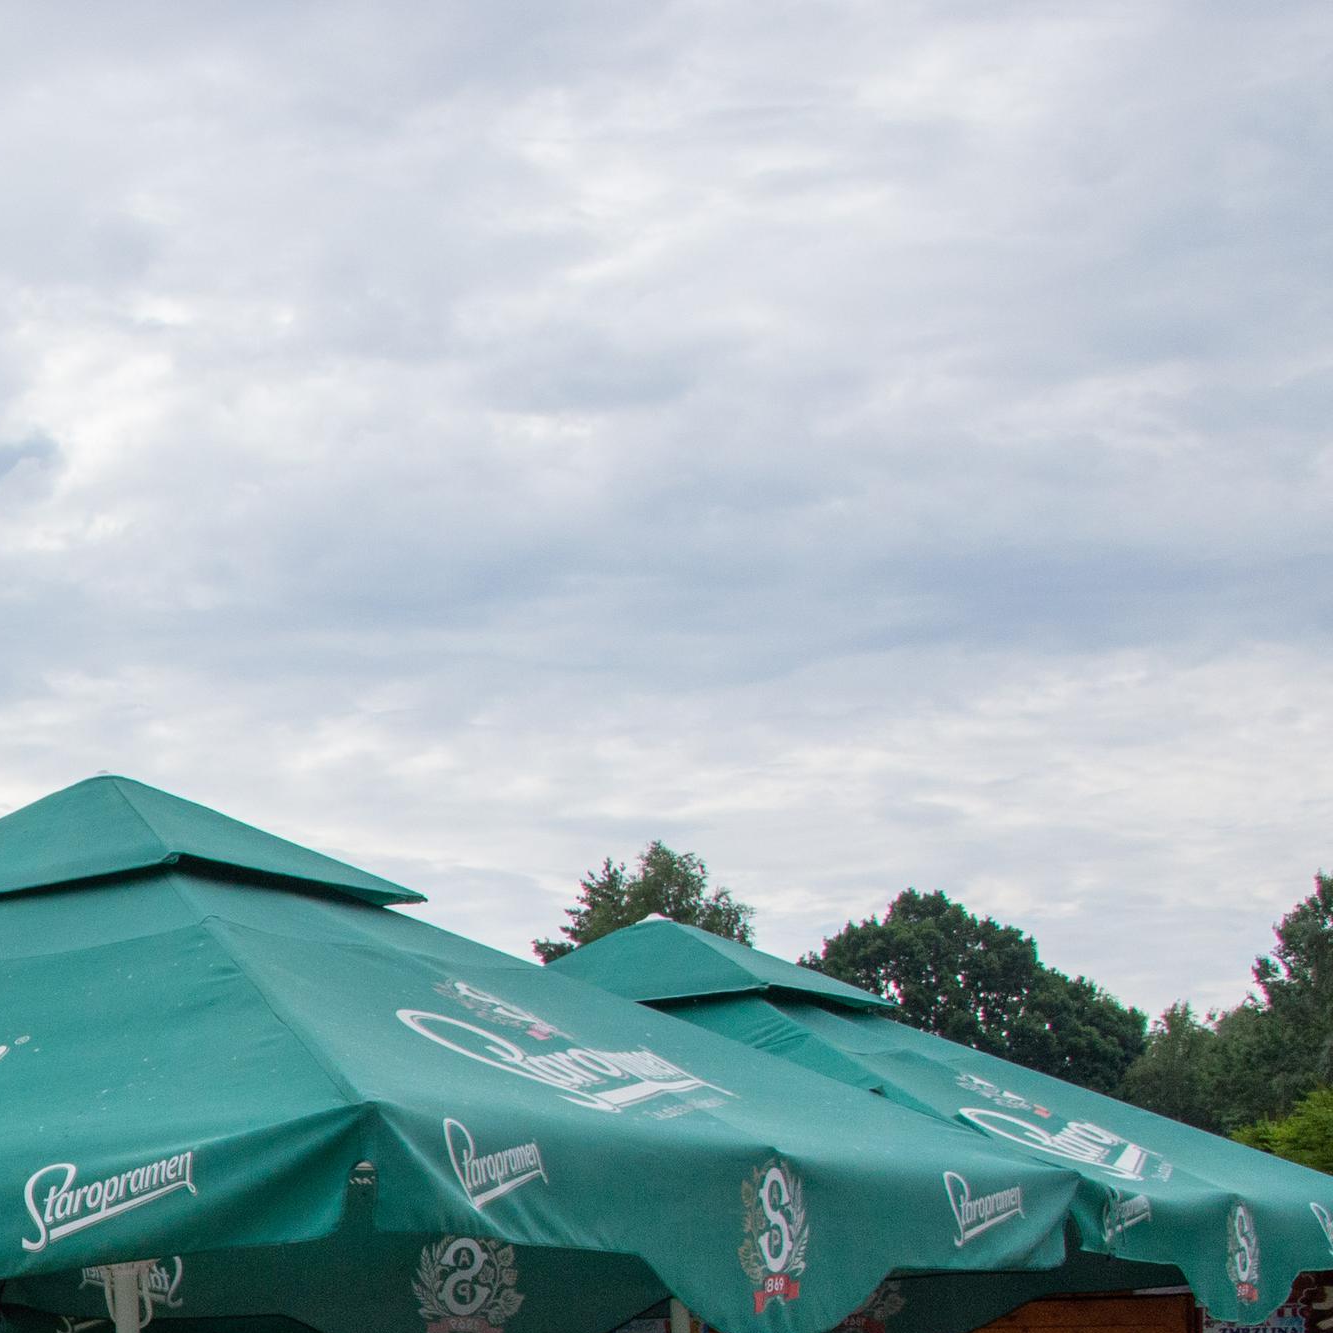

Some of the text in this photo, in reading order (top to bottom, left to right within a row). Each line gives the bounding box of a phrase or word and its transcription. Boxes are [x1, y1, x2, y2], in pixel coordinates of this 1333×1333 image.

[22, 1151, 196, 1253] Staropramen
[443, 1117, 549, 1210] Staropramen
[944, 1171, 1025, 1247] Staropramen
